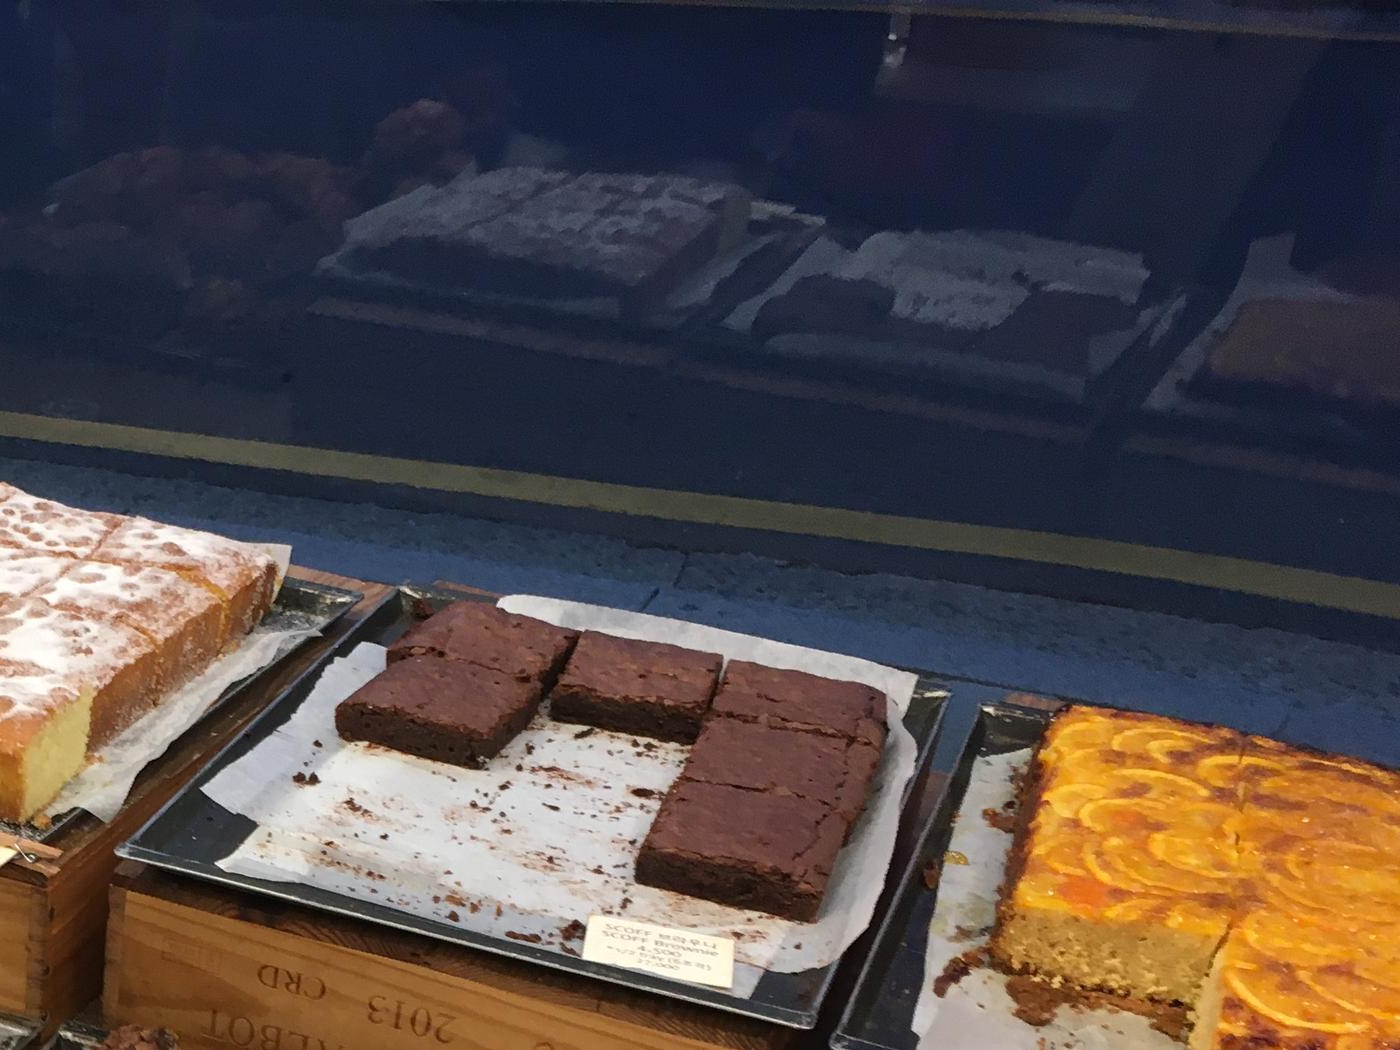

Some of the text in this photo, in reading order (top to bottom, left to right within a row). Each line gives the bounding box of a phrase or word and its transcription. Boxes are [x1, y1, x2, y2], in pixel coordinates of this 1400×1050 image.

[601, 930, 719, 957] SCOFF Brownie
[605, 923, 652, 936] SCOFF
[256, 963, 327, 1001] CRD
[366, 994, 458, 1045] 2013
